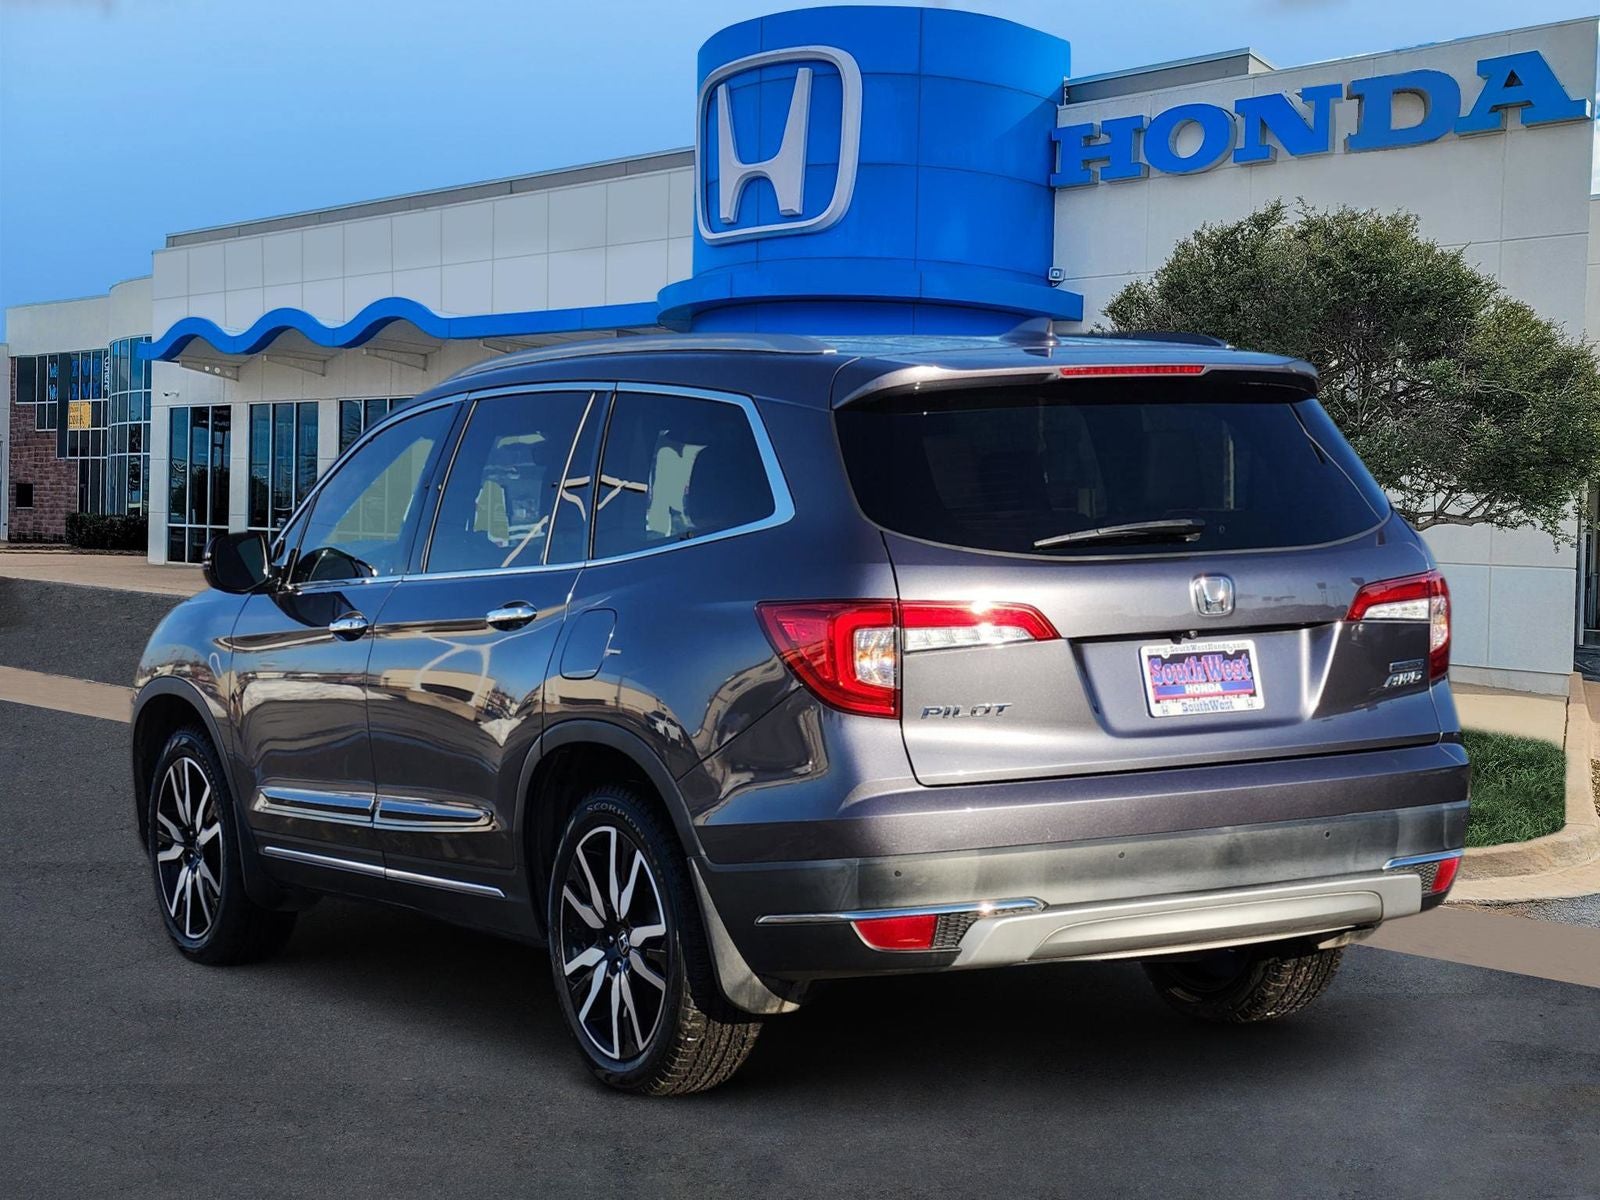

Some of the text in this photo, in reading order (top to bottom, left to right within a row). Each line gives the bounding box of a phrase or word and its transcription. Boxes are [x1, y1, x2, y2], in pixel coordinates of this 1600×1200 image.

[1050, 50, 1591, 188] HONDA
[1149, 653, 1253, 685] SouthWest
[1184, 682, 1224, 694] HONDA
[921, 702, 1013, 719] PILOT
[1181, 700, 1234, 713] SouthWest
[586, 802, 645, 840] SCORPION
